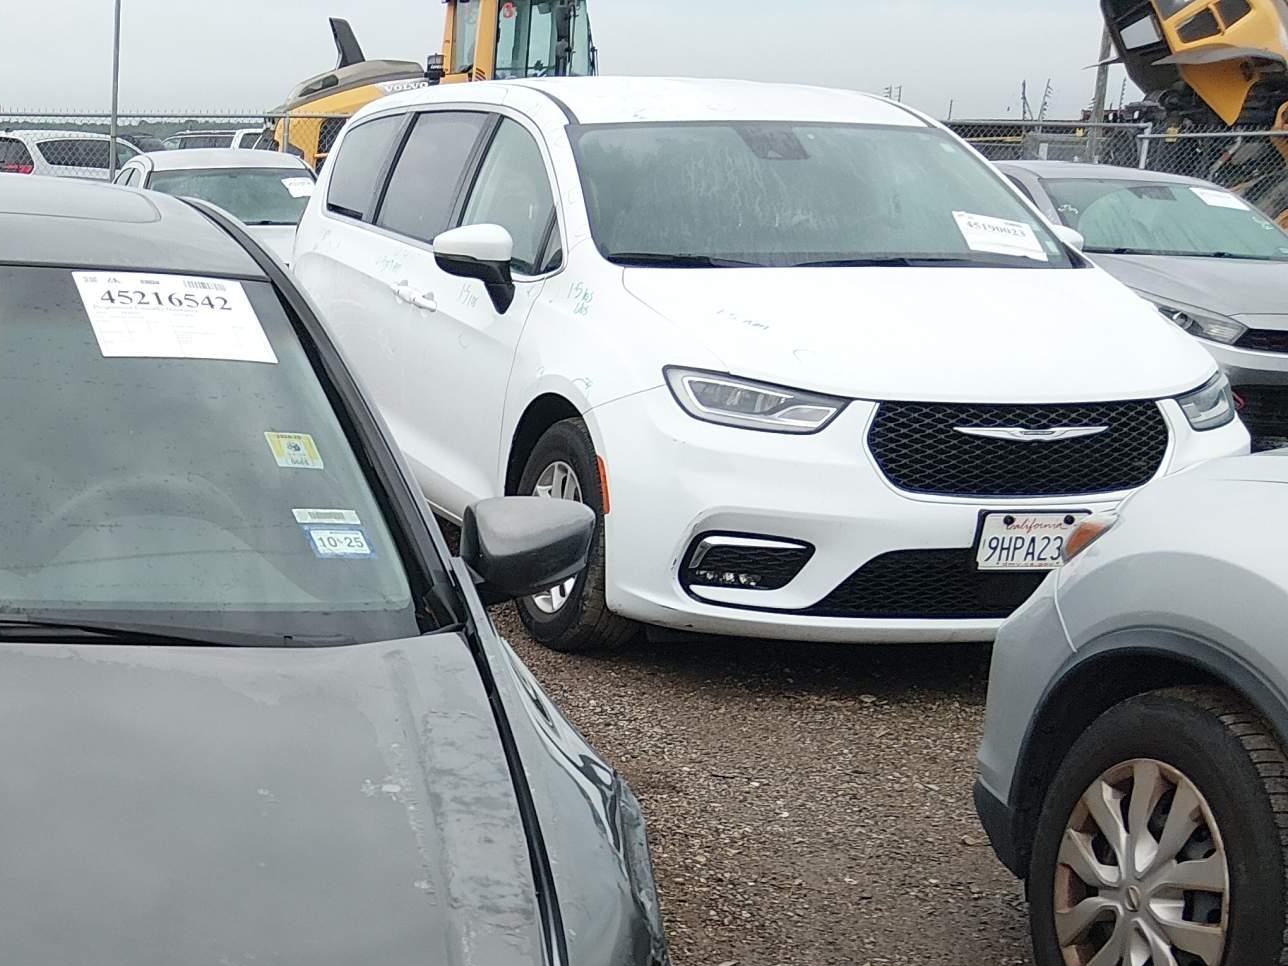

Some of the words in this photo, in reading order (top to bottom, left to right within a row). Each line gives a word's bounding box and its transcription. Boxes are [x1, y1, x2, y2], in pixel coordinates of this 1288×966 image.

[384, 80, 429, 92] VOLVO
[100, 289, 232, 311] 45216542
[983, 536, 1064, 562] 9HPA23
